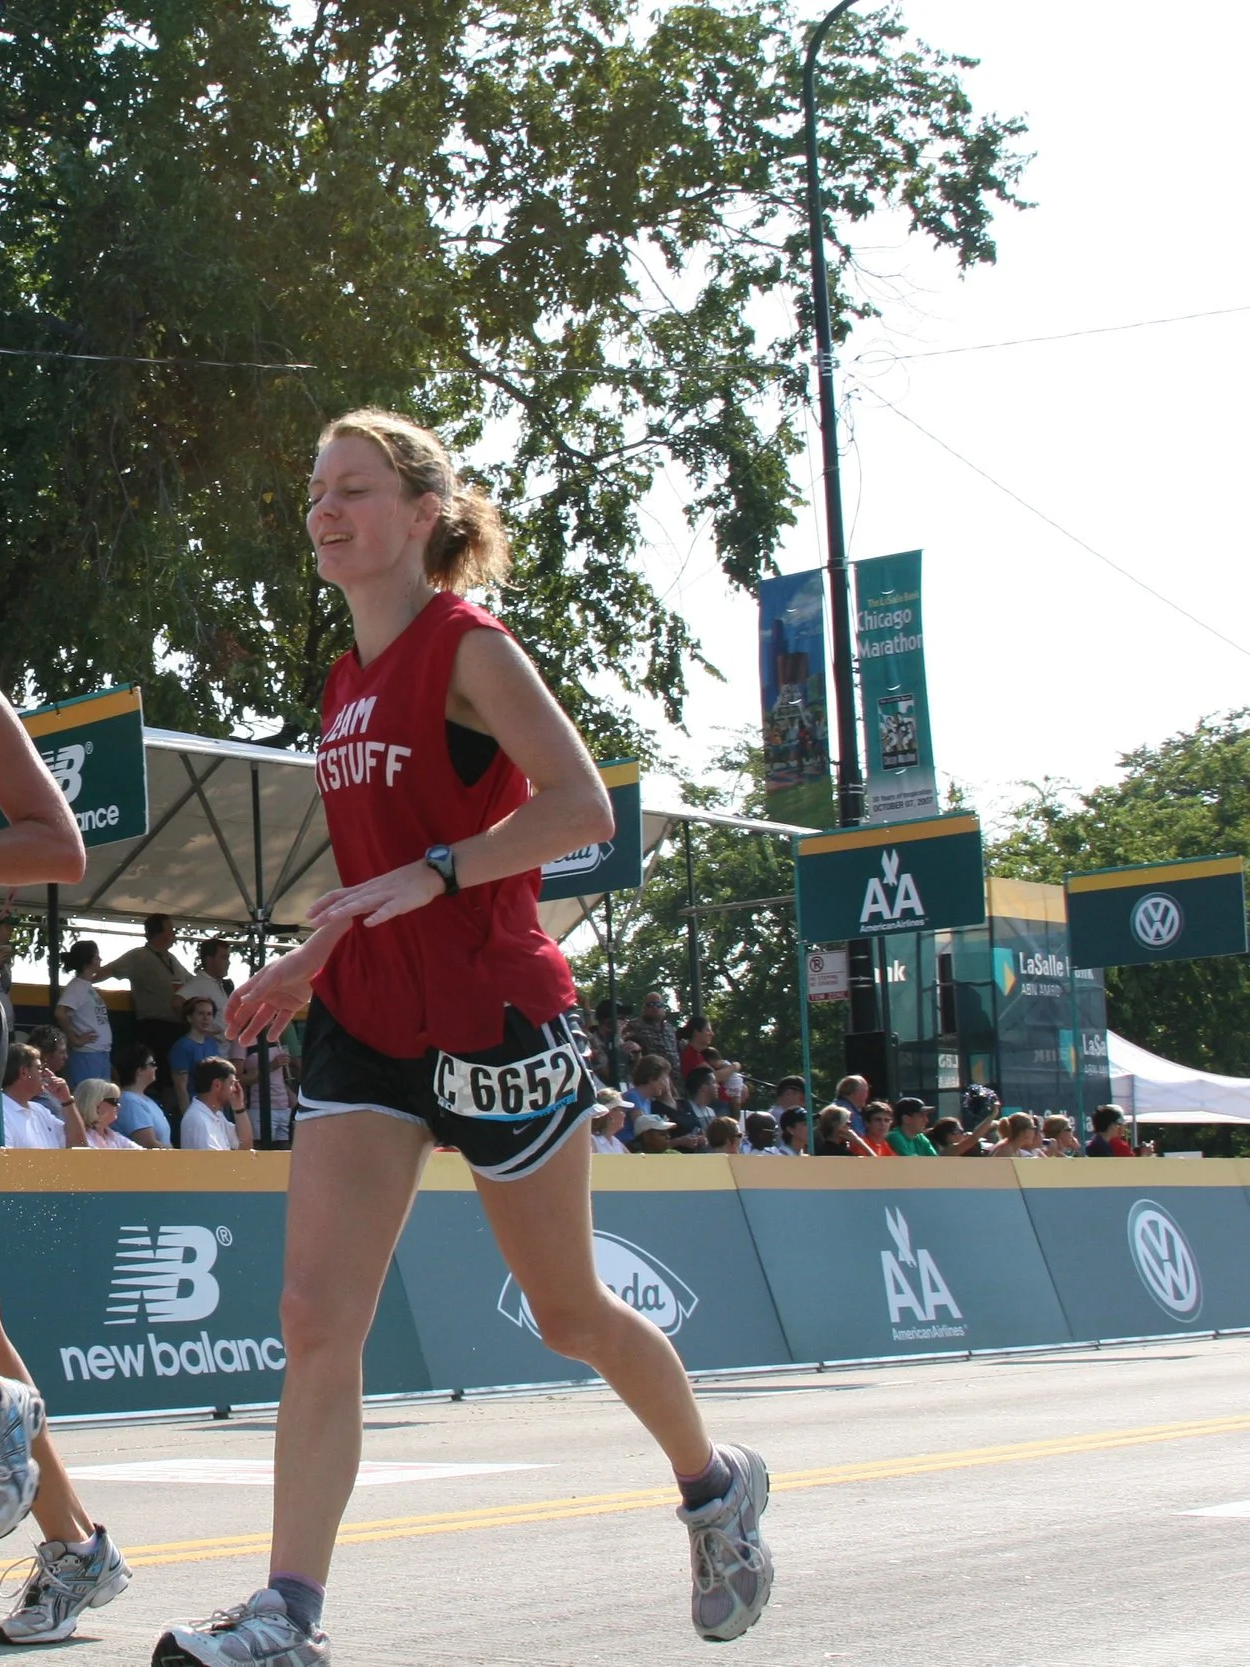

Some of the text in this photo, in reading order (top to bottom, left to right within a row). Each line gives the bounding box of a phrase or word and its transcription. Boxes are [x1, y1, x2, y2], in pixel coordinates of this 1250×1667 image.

[857, 608, 912, 631] Chicago
[320, 696, 377, 746] EAM
[316, 741, 412, 796] TSTUFF
[76, 804, 120, 832] ance
[873, 801, 903, 812] OCTOBER
[1019, 951, 1064, 977] LaSalle
[1082, 1034, 1107, 1057] LaSa
[470, 1051, 576, 1114] 6652
[59, 1331, 287, 1381] new balanc
